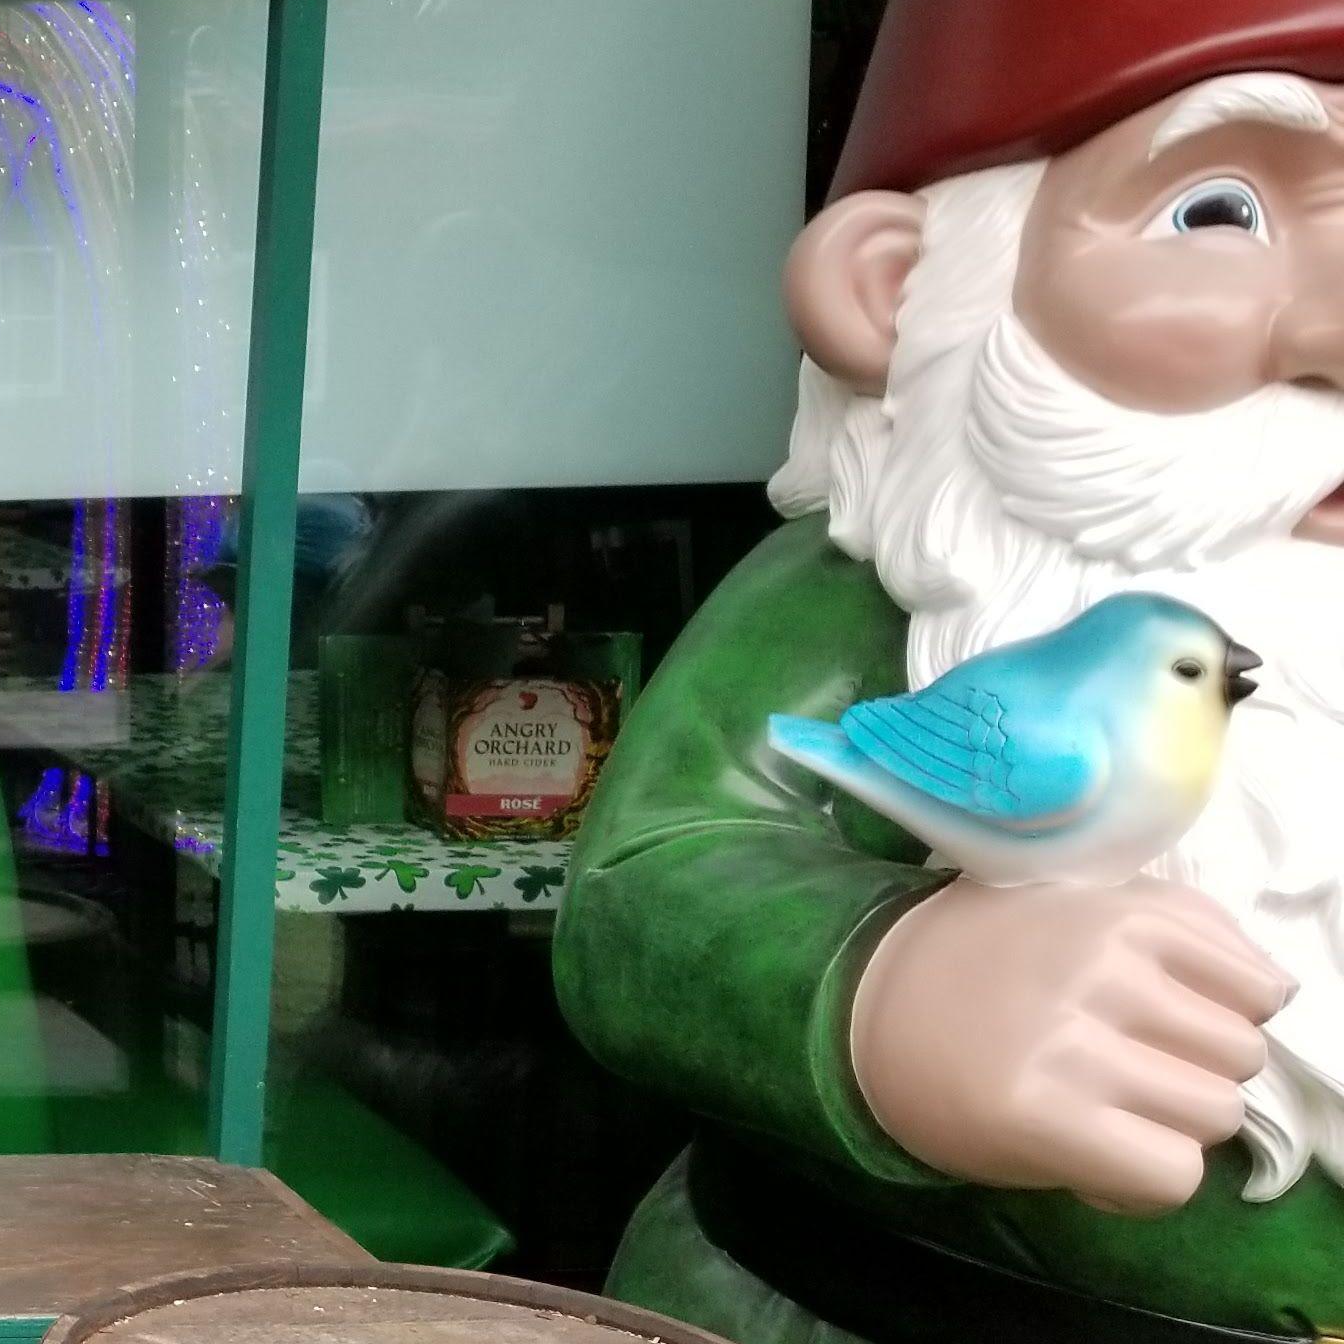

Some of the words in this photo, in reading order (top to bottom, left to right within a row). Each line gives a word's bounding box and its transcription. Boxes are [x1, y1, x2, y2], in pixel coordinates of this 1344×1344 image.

[490, 722, 559, 739] ANGRY
[474, 739, 572, 756] ORCHARD
[488, 758, 519, 768] HARD
[523, 758, 558, 768] CIDER
[500, 795, 542, 810] ROSÉ
